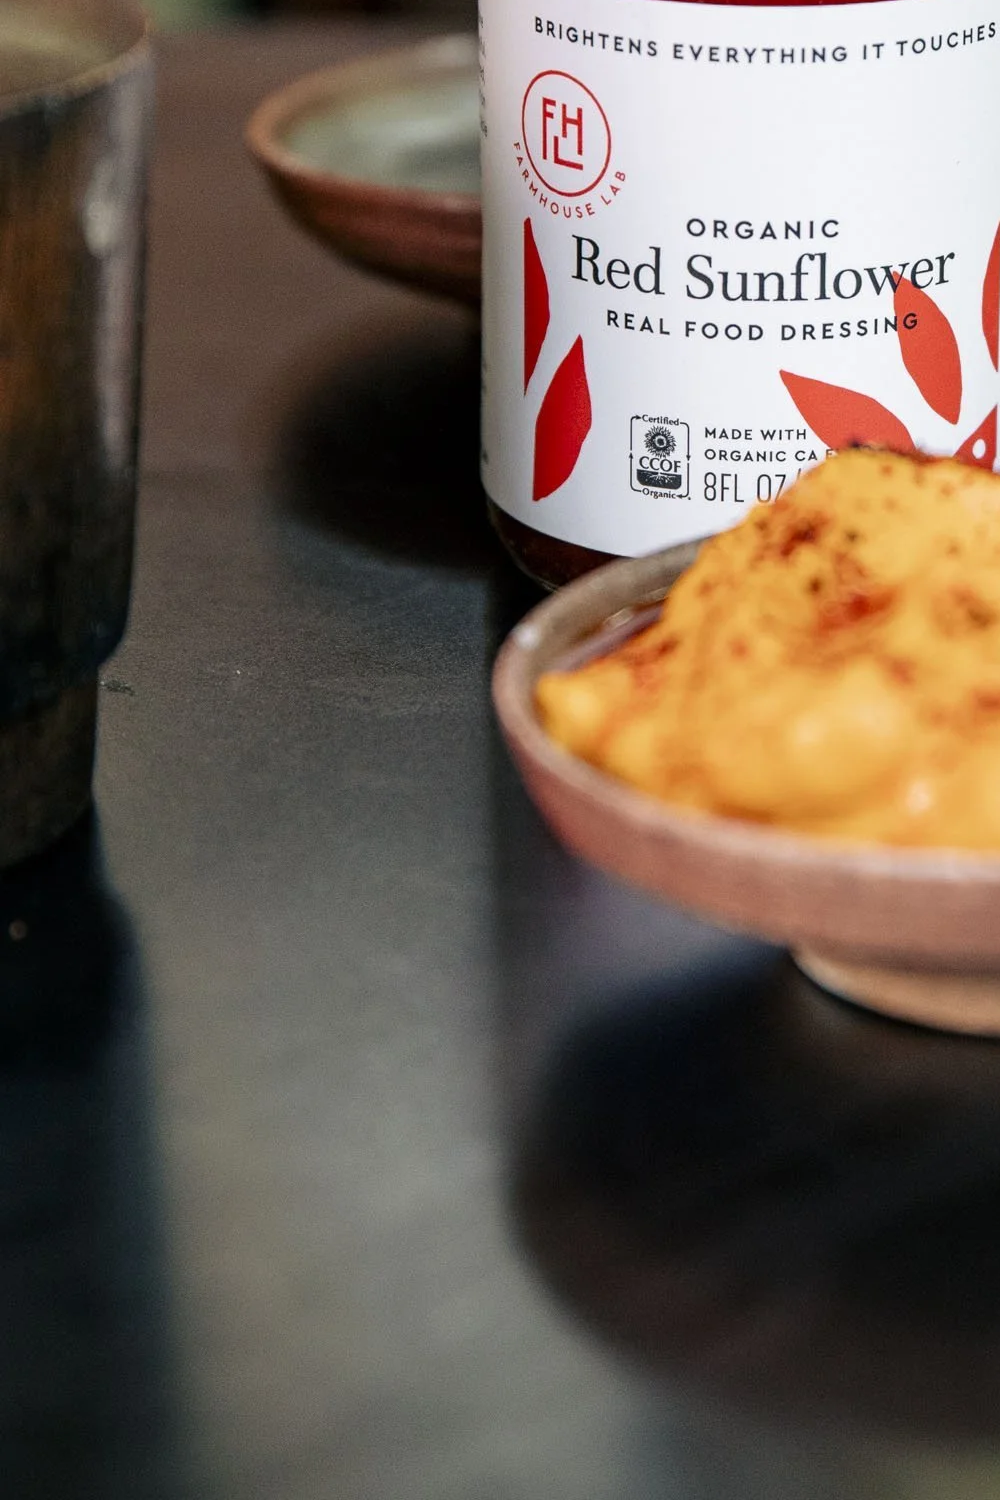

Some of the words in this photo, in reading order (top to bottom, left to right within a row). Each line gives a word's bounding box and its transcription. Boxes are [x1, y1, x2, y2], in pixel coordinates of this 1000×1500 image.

[535, 16, 658, 57] BRIGHTENS
[673, 43, 847, 64] EVERYTHING
[862, 43, 885, 60] IT
[896, 22, 996, 56] TOUCHES
[513, 141, 596, 219] FARMHOUSE
[600, 171, 627, 206] LAB
[686, 218, 840, 240] ORGANIC
[571, 234, 665, 296] Red
[685, 250, 956, 302] Sunflower
[606, 310, 671, 335] REAL
[684, 321, 764, 341] FOOD
[781, 312, 918, 341] DRESSING
[641, 414, 680, 426] Certified
[704, 426, 753, 441] MADE
[760, 428, 807, 441] WITH
[638, 456, 681, 473] CCOF
[704, 448, 787, 462] ORGANIC
[794, 450, 818, 462] CA
[642, 487, 677, 500] Organic
